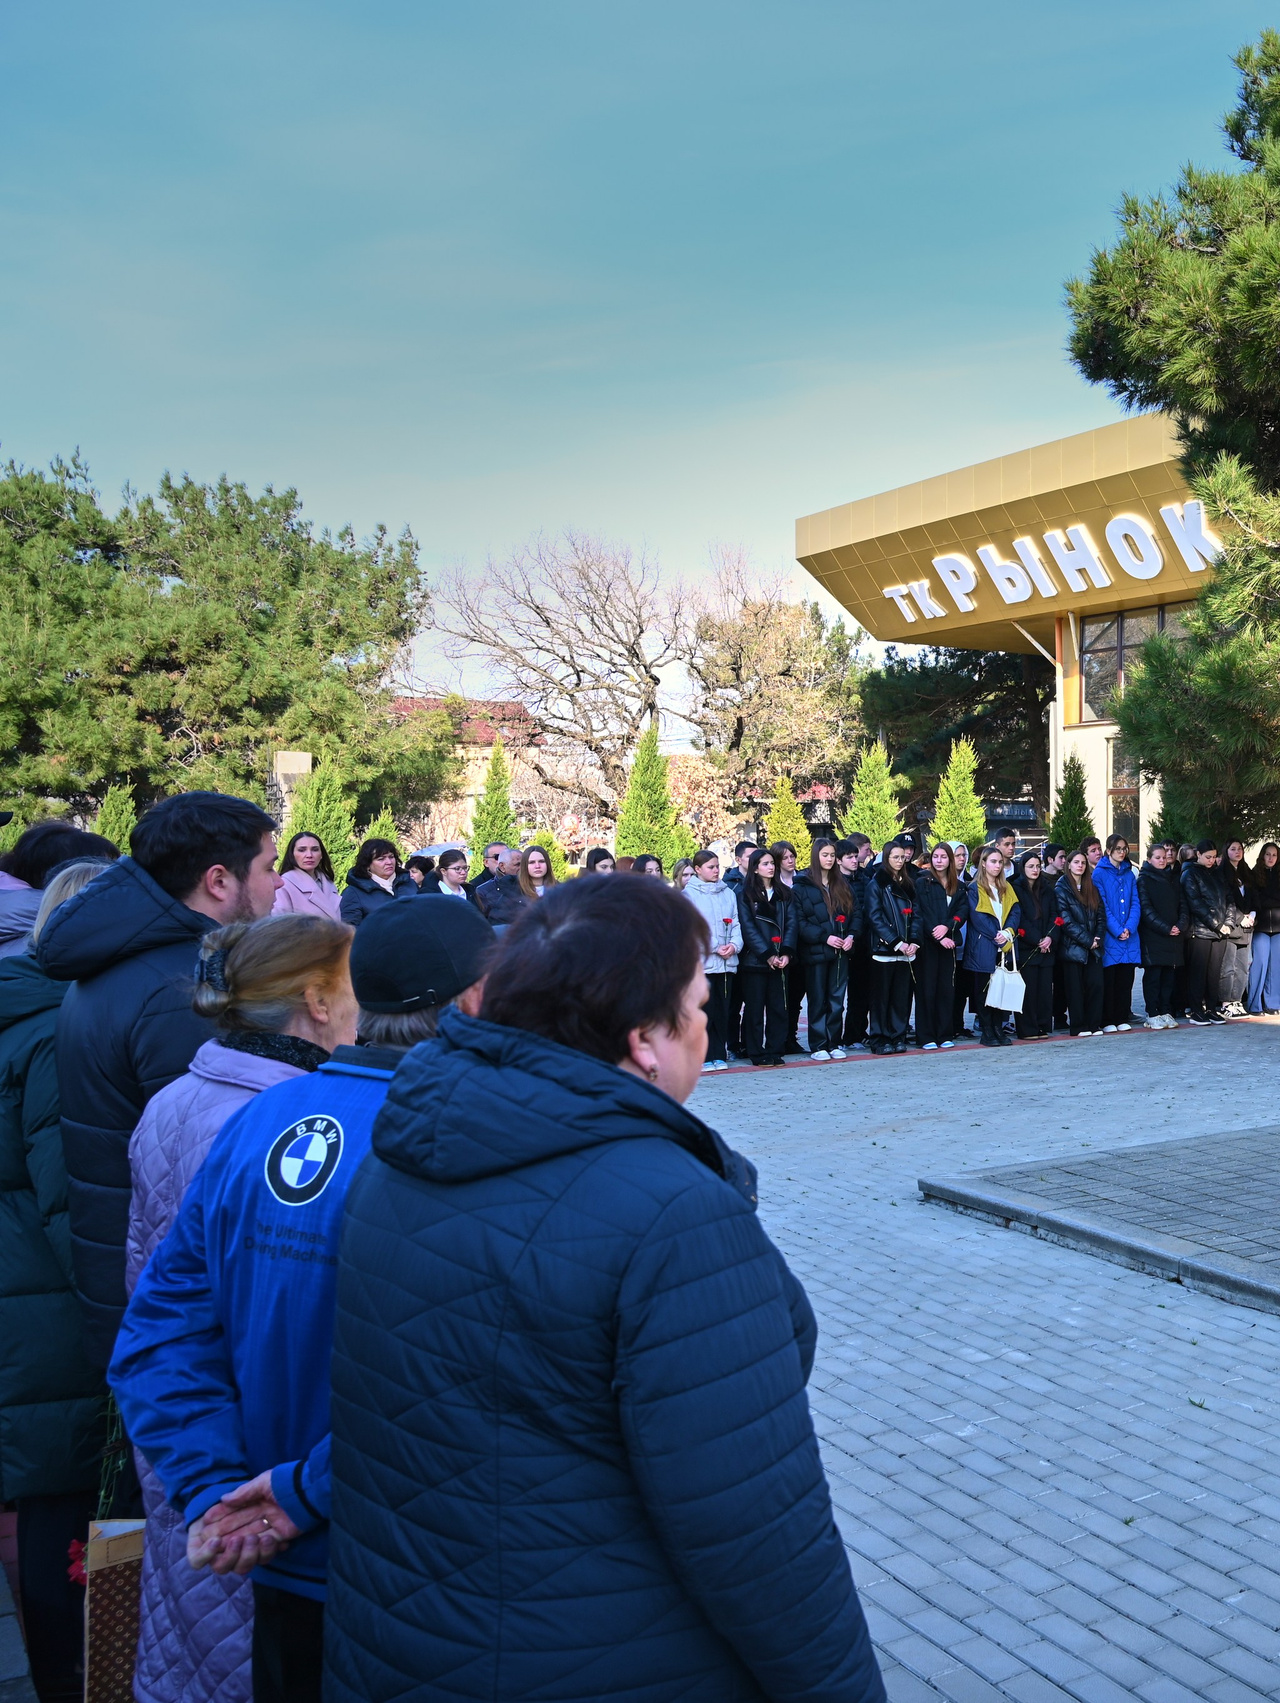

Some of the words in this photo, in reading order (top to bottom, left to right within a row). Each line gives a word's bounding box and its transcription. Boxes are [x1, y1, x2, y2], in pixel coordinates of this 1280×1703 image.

[882, 579, 947, 624] ТК
[932, 500, 1223, 613] РЫНОК
[296, 1120, 338, 1145] BMW
[255, 1219, 272, 1235] he
[280, 1244, 338, 1266] Machne
